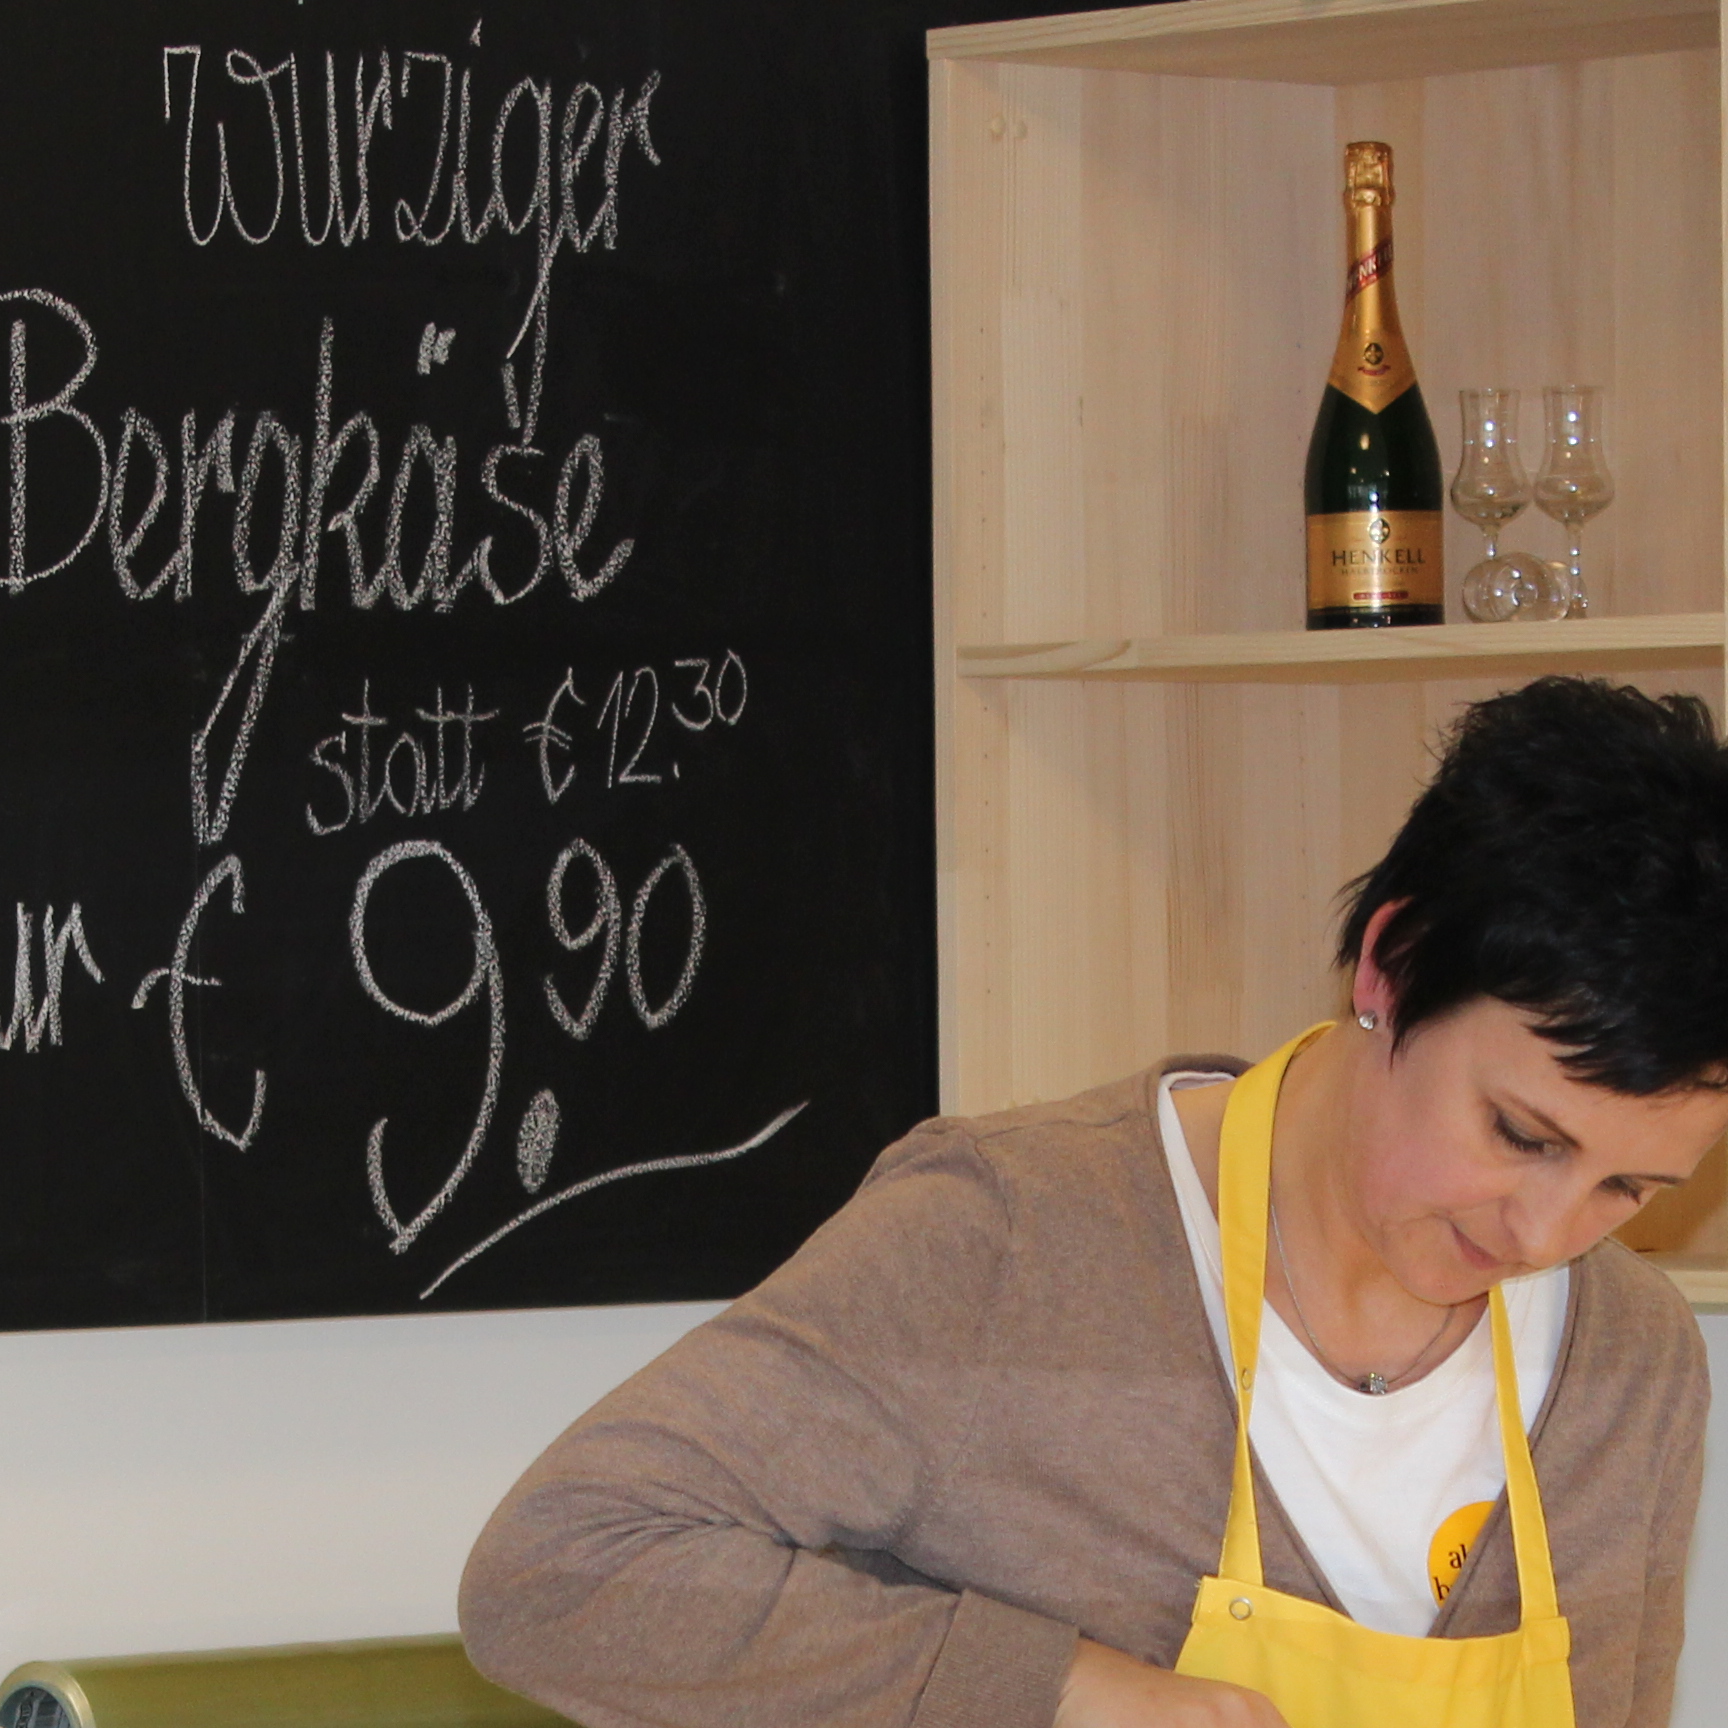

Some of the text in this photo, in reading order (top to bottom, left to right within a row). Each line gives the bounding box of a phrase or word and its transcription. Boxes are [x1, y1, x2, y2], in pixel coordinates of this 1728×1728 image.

[1332, 548, 1426, 566] HENKELL
[306, 679, 499, 836] statt
[523, 668, 585, 803] €
[132, 854, 267, 1151] €
